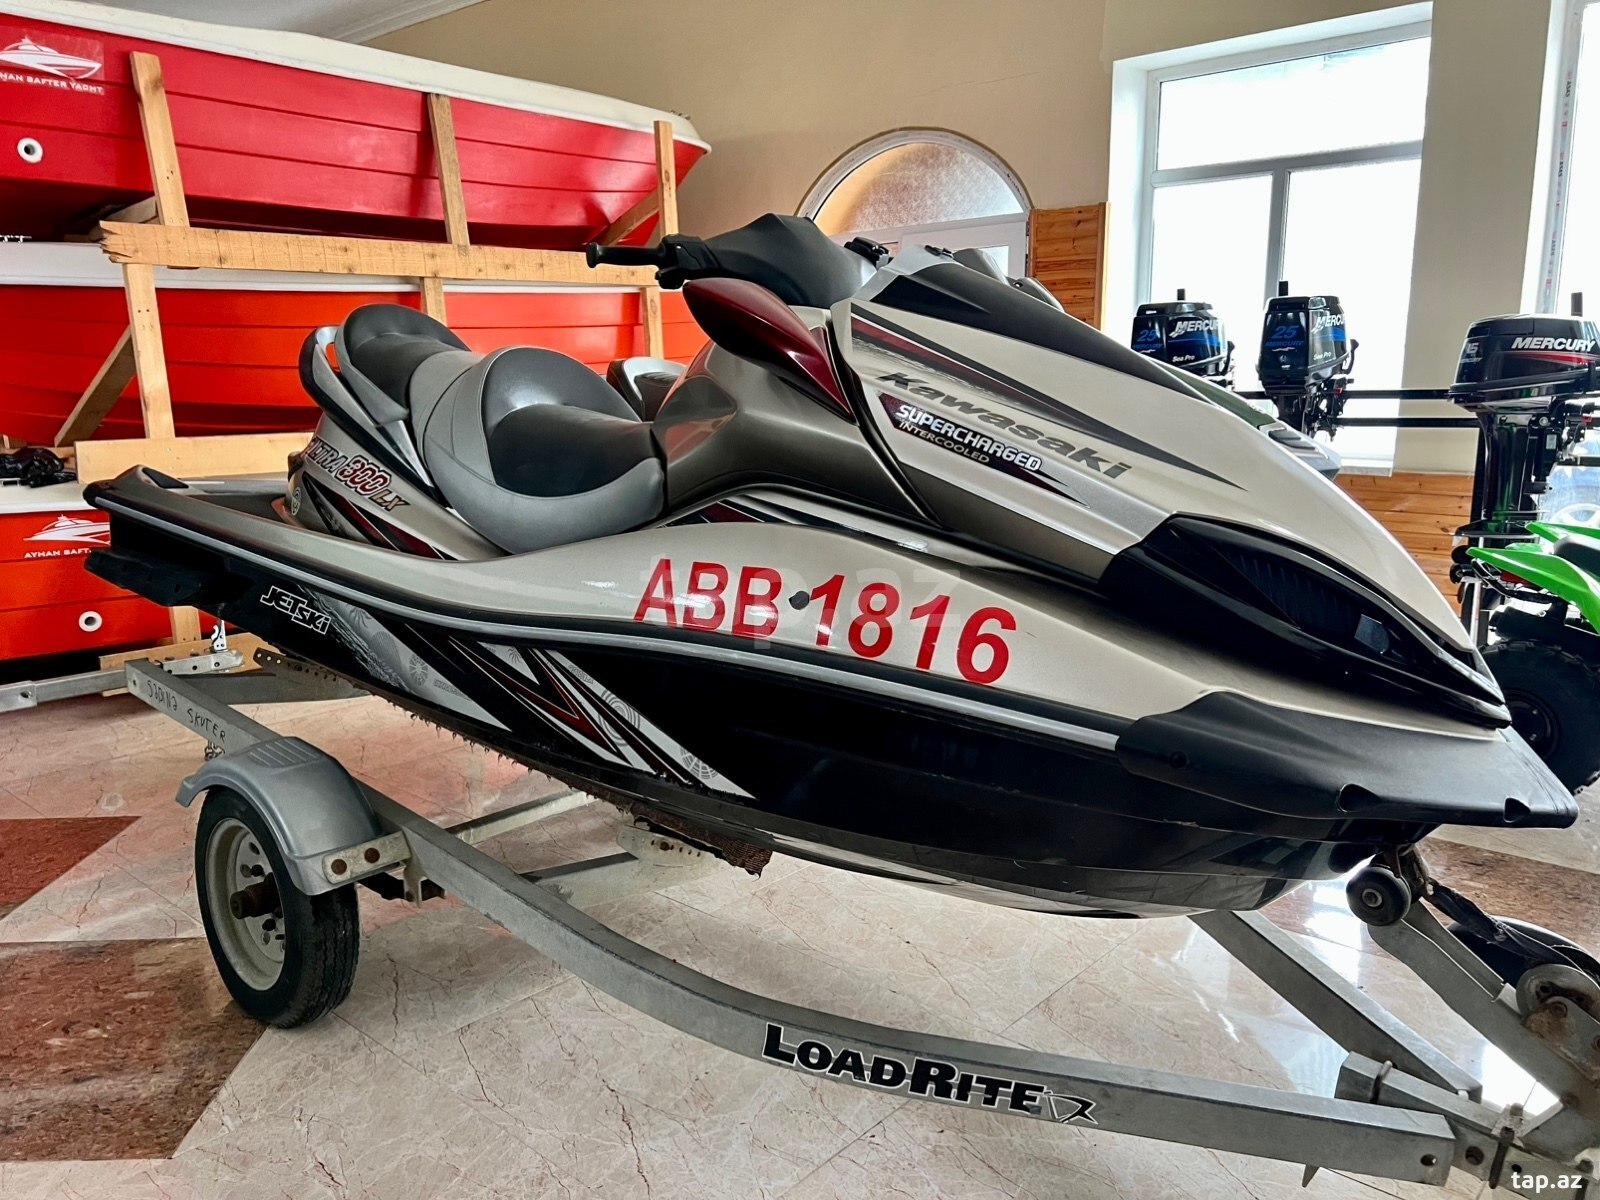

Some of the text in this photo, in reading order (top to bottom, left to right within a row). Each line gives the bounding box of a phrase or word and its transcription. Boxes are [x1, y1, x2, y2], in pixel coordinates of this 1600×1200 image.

[0, 72, 23, 82] HAN
[1137, 329, 1157, 341] 25
[1170, 319, 1219, 336] MERCUR
[1271, 325, 1299, 339] 25
[1510, 337, 1596, 351] MERCURY
[878, 372, 1132, 479] Kawasaki
[895, 404, 1042, 472] SUPERCHARGED
[899, 420, 990, 464] INTERCOOLED
[336, 455, 392, 496] 300
[369, 488, 411, 512] LX
[24, 550, 60, 558] AYHAN
[633, 558, 1017, 685] ABB 1816
